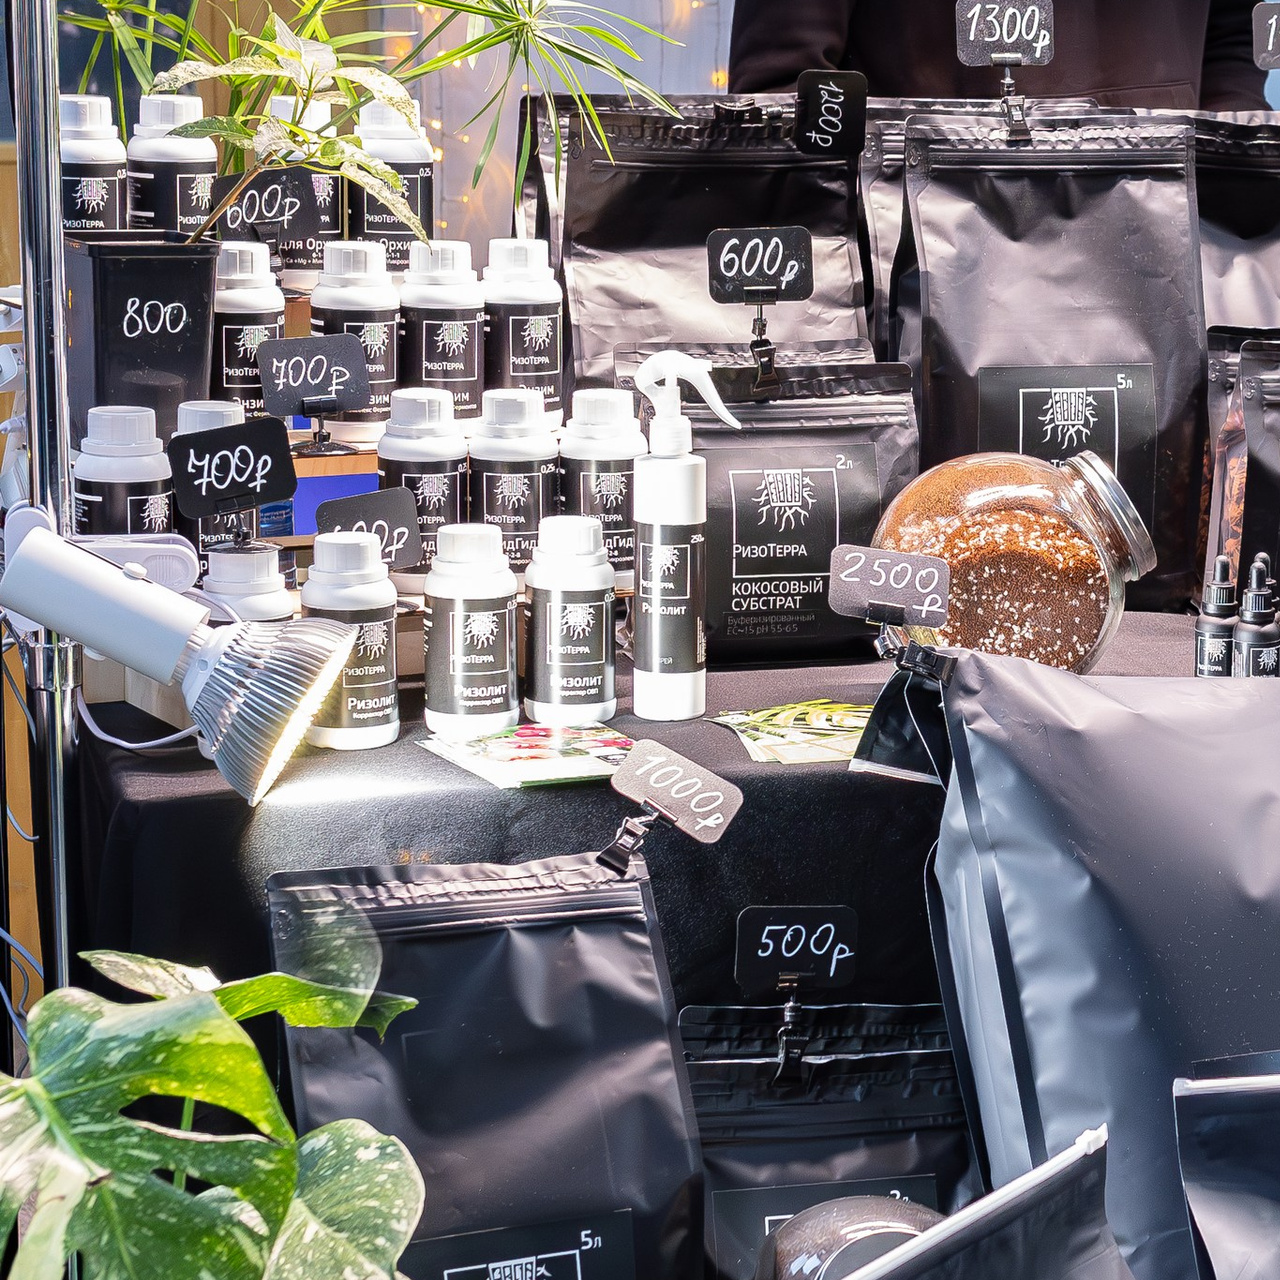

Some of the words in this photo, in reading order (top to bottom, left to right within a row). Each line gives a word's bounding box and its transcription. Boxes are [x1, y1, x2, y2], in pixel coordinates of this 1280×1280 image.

[122, 296, 188, 338] 800
[1116, 373, 1133, 389] 5л
[232, 396, 264, 409] Энзи
[368, 394, 391, 405] зим
[835, 454, 853, 470] 2л
[732, 577, 824, 596] КОКОСОВЫЙ
[731, 596, 803, 612] СУБСТРАТ
[551, 675, 604, 689] изолит
[580, 1229, 602, 1250] 5л
